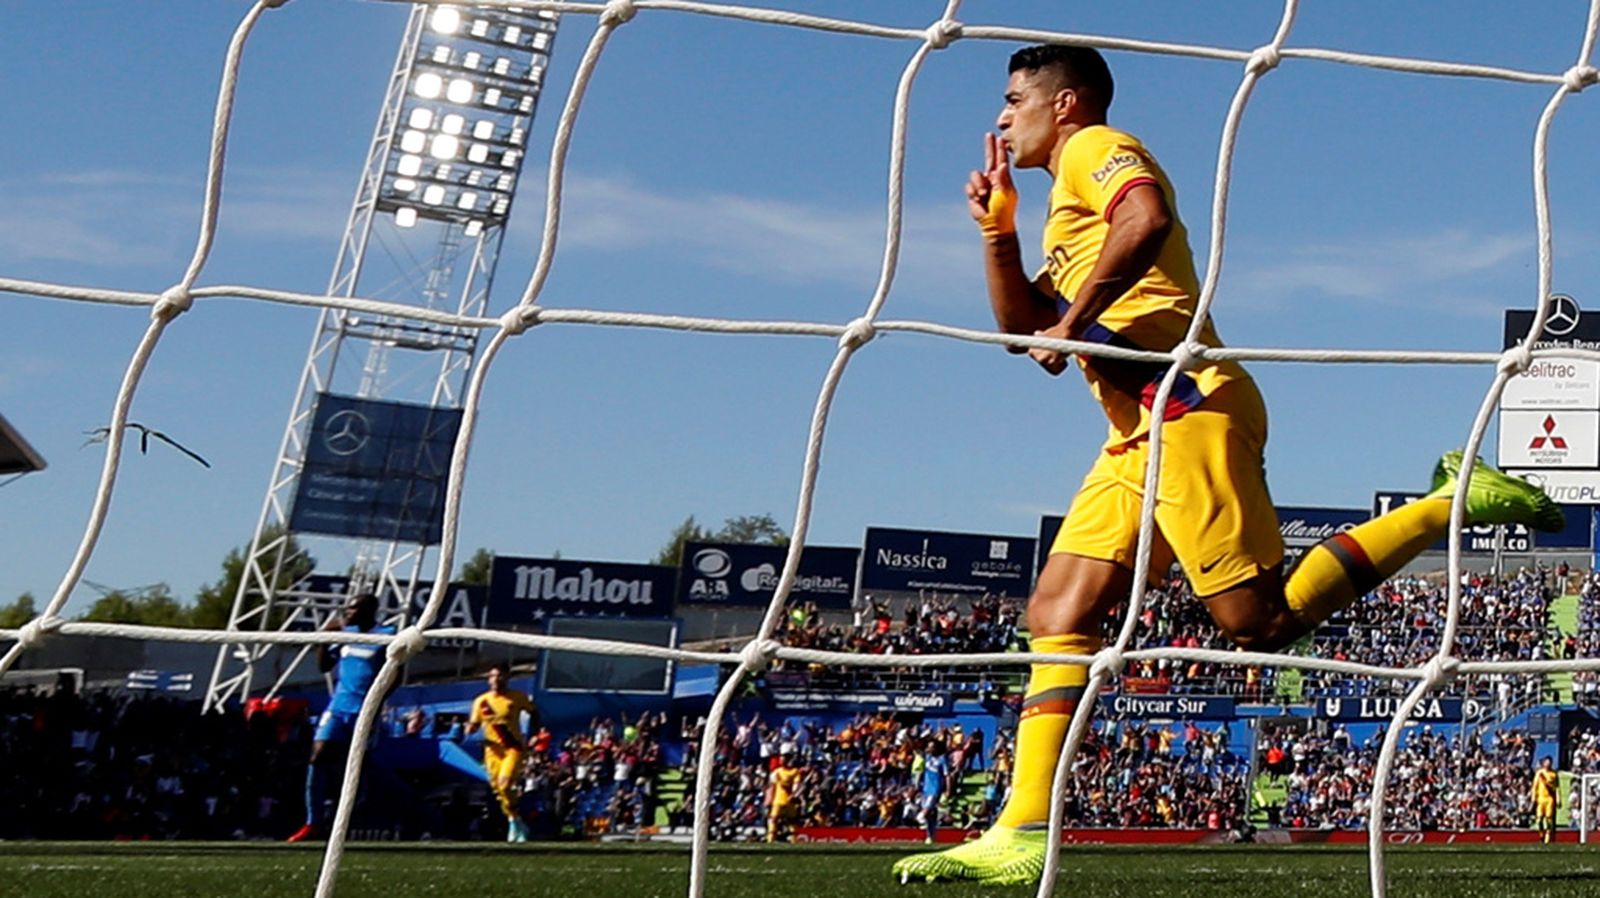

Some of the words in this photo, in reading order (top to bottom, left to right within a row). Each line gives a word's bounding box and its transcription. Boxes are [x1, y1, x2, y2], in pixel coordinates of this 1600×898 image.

[1091, 153, 1138, 182] beko
[877, 539, 948, 570] Nassica
[513, 565, 654, 605] Mahou
[894, 692, 945, 708] winwin
[1114, 696, 1174, 716] Citycar
[1176, 697, 1208, 714] Sur
